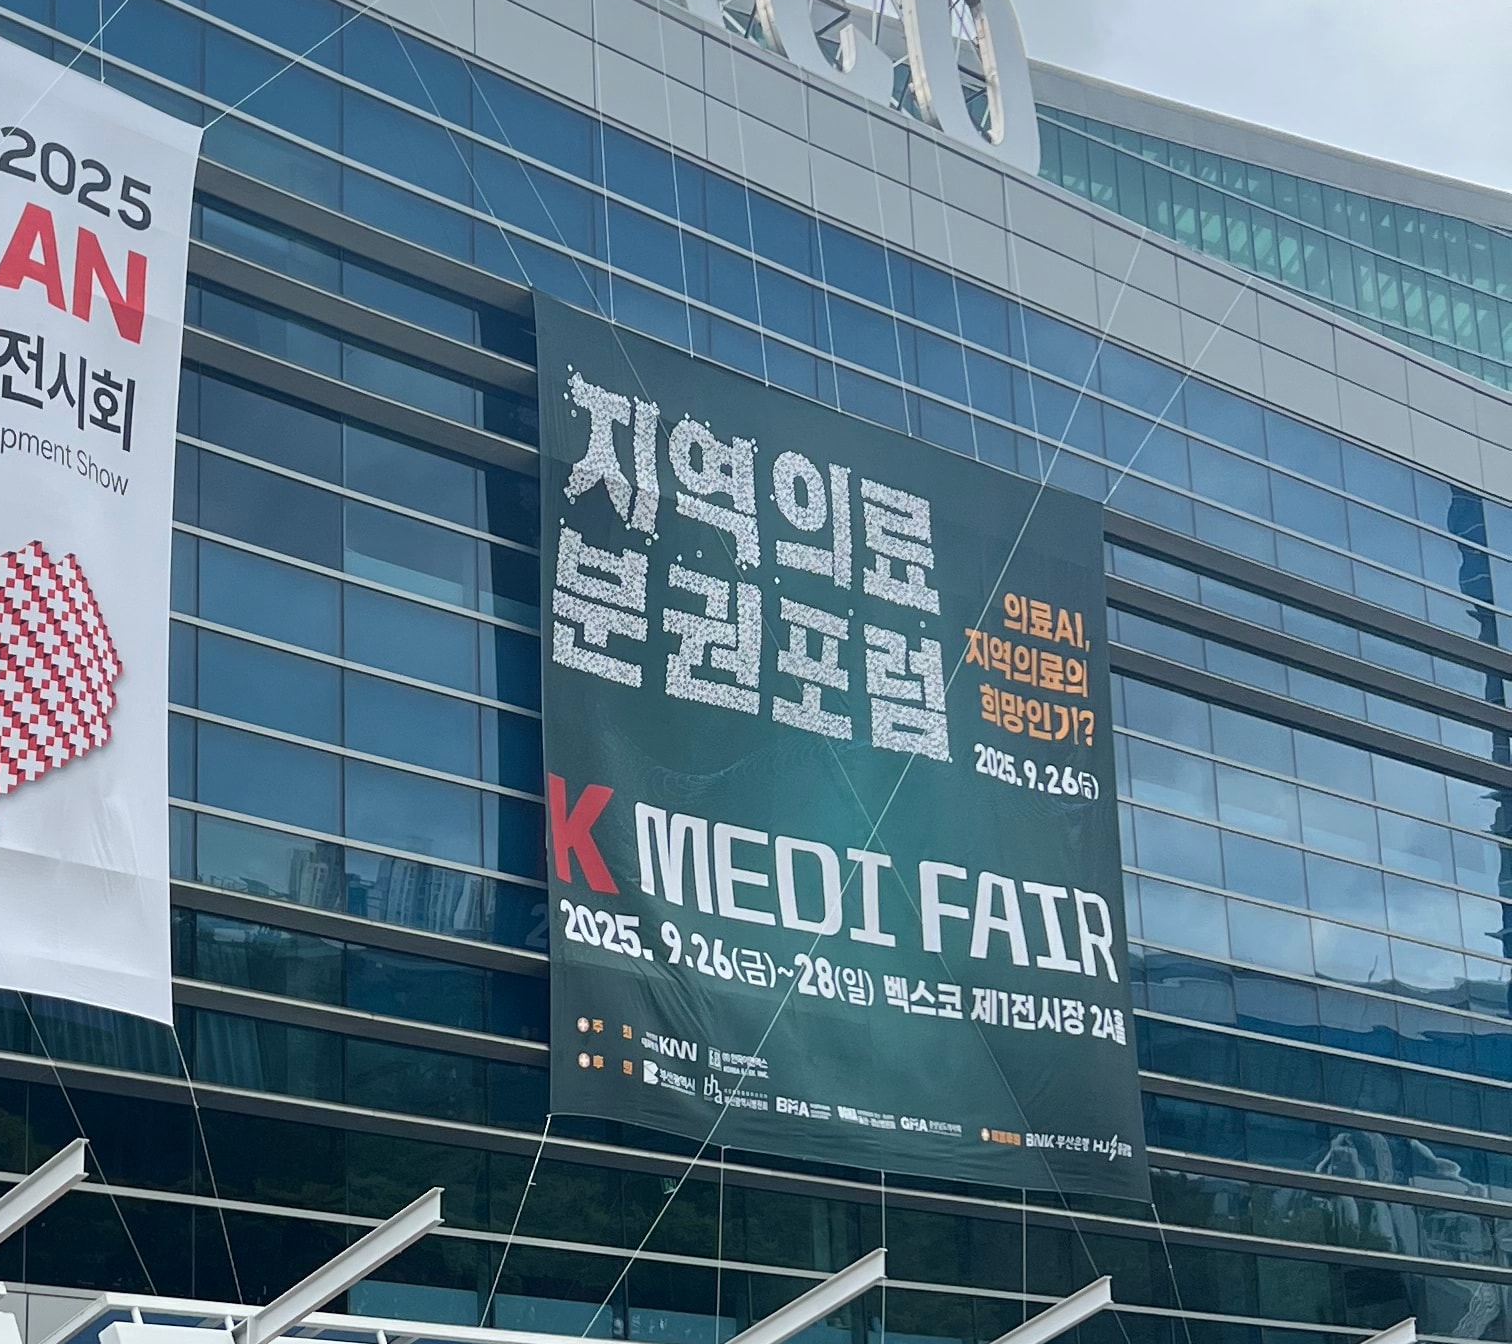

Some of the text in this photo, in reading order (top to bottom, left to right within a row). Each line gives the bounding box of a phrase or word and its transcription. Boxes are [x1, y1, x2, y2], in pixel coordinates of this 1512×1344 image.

[76, 455, 129, 496] Show
[563, 368, 941, 616] 지역의료
[552, 526, 951, 762] 분권포럼
[1002, 592, 1091, 652] 의료AI,
[964, 627, 1088, 698] 지역의료의
[546, 771, 1120, 984] K MEDI FAIR
[559, 898, 654, 962] 2025.
[884, 975, 964, 1021] 벡스코
[970, 986, 1085, 1035] 제1전시장
[658, 1035, 698, 1062] KNN
[1055, 1134, 1090, 1152] 부산은행
